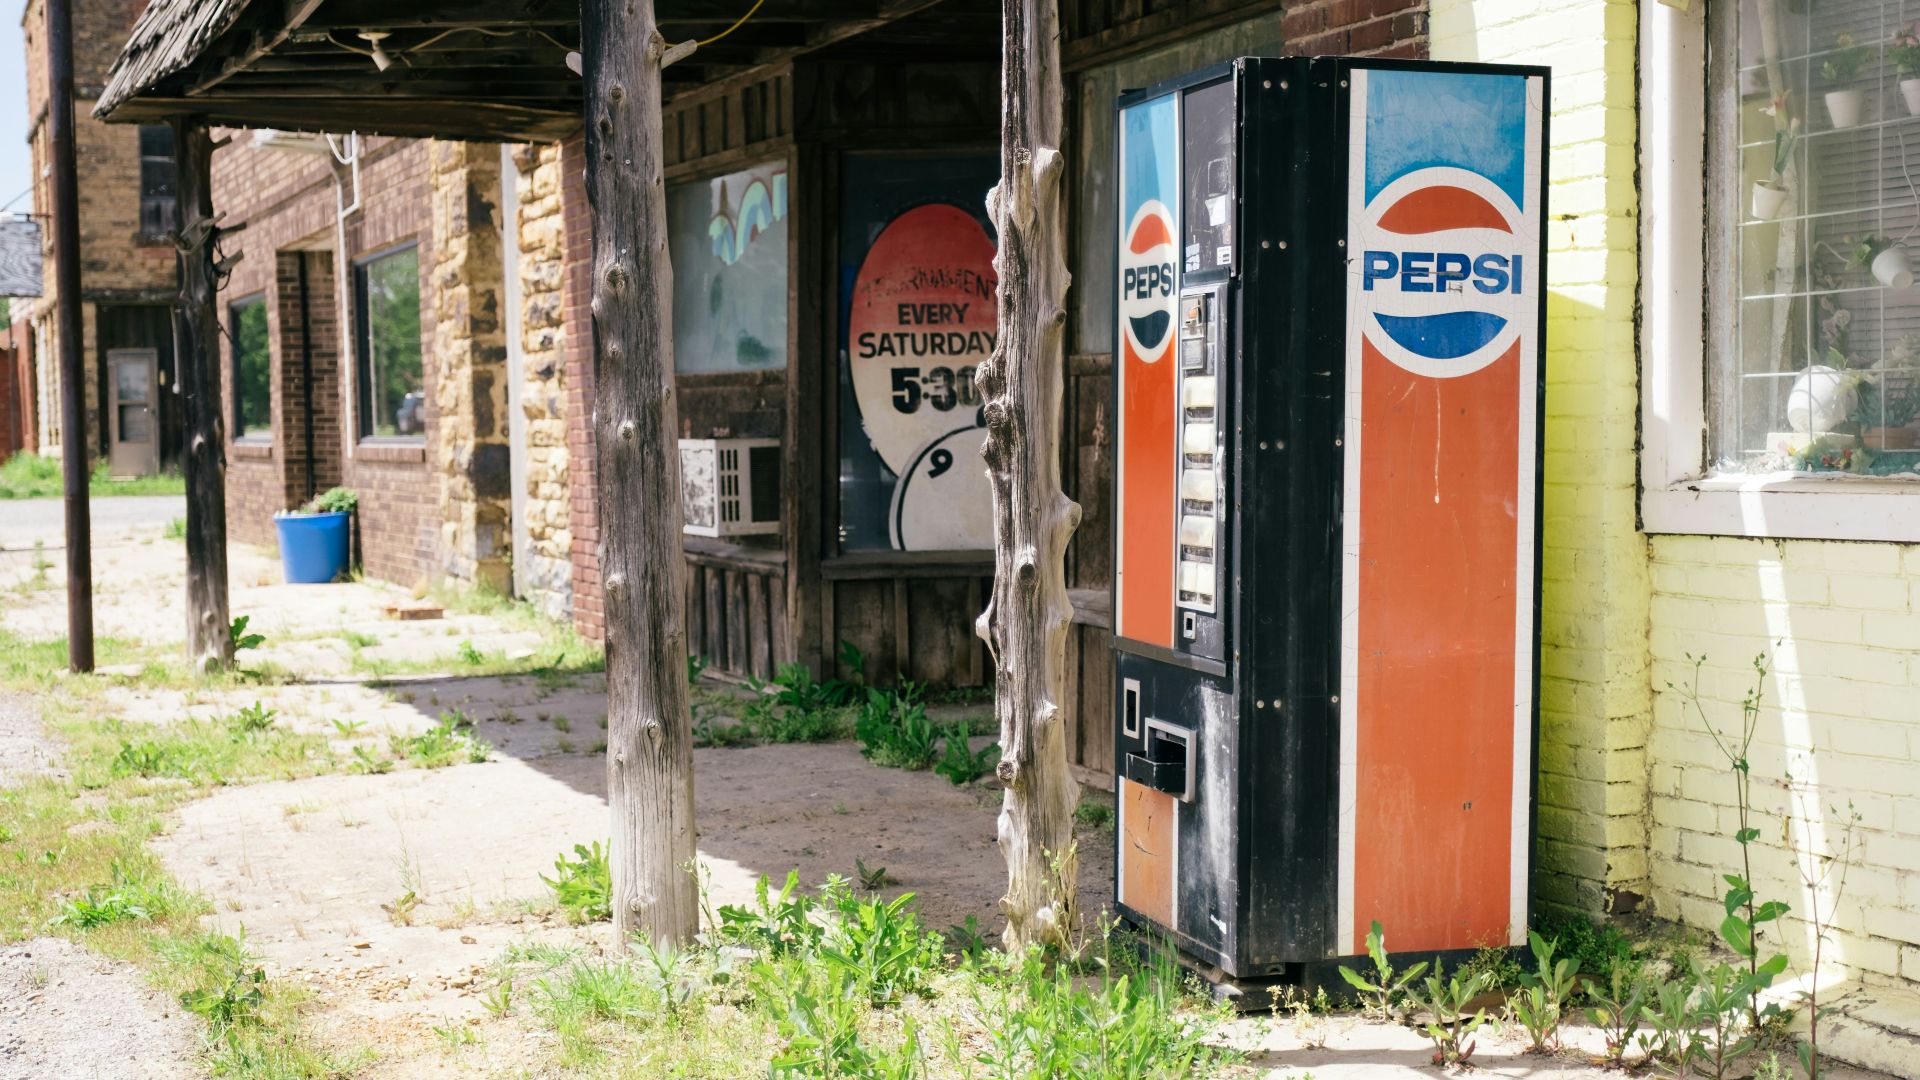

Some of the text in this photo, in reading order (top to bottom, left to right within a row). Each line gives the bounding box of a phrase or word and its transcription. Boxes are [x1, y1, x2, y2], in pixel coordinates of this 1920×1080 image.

[1124, 262, 1176, 301] PEPSI
[1363, 250, 1523, 295] PEPSI
[898, 303, 970, 325] EVERY
[858, 331, 997, 359] SATURDAY
[891, 366, 980, 415] 5:30
[928, 448, 953, 479] 9
